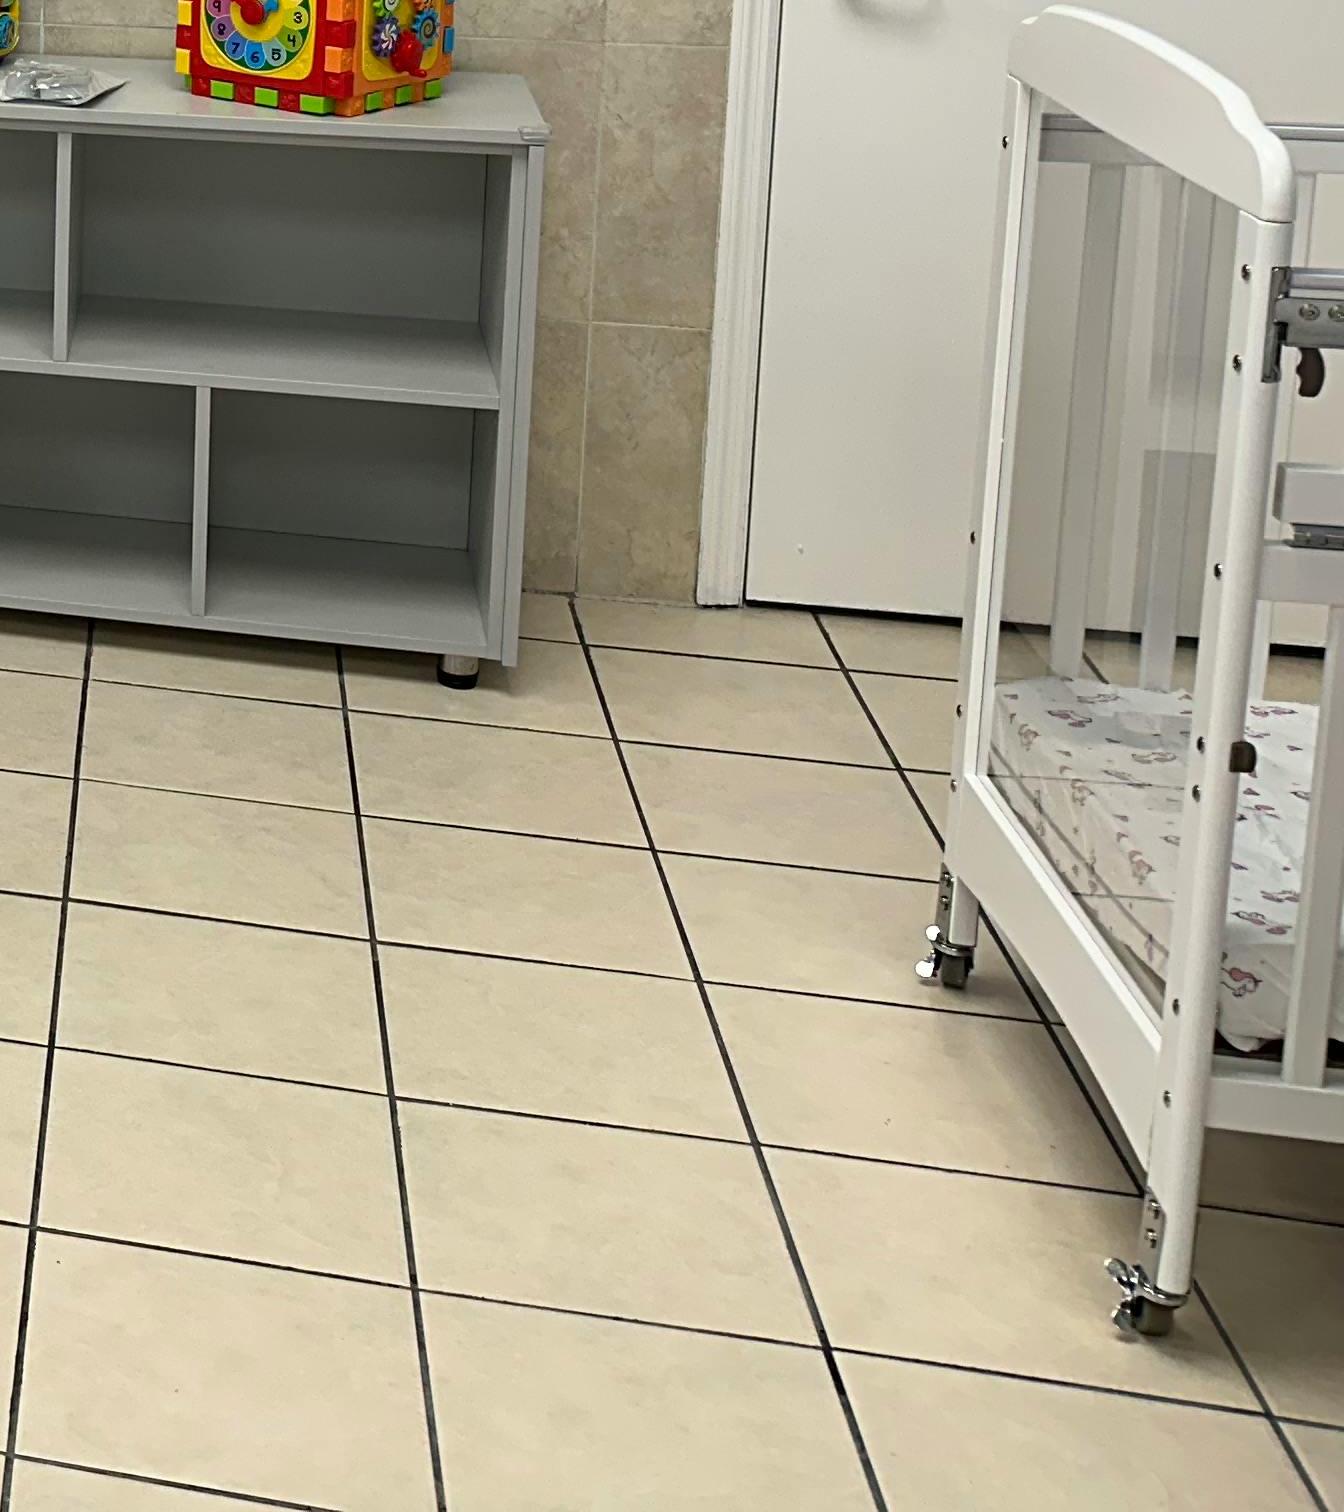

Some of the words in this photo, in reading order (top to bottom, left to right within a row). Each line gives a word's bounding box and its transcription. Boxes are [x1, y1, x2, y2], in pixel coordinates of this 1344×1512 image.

[212, 0, 222, 12] 9
[293, 11, 303, 24] 3
[217, 22, 226, 36] 8
[287, 33, 296, 47] 4
[231, 42, 241, 54] 7
[271, 48, 282, 61] 5
[250, 51, 260, 63] 6
